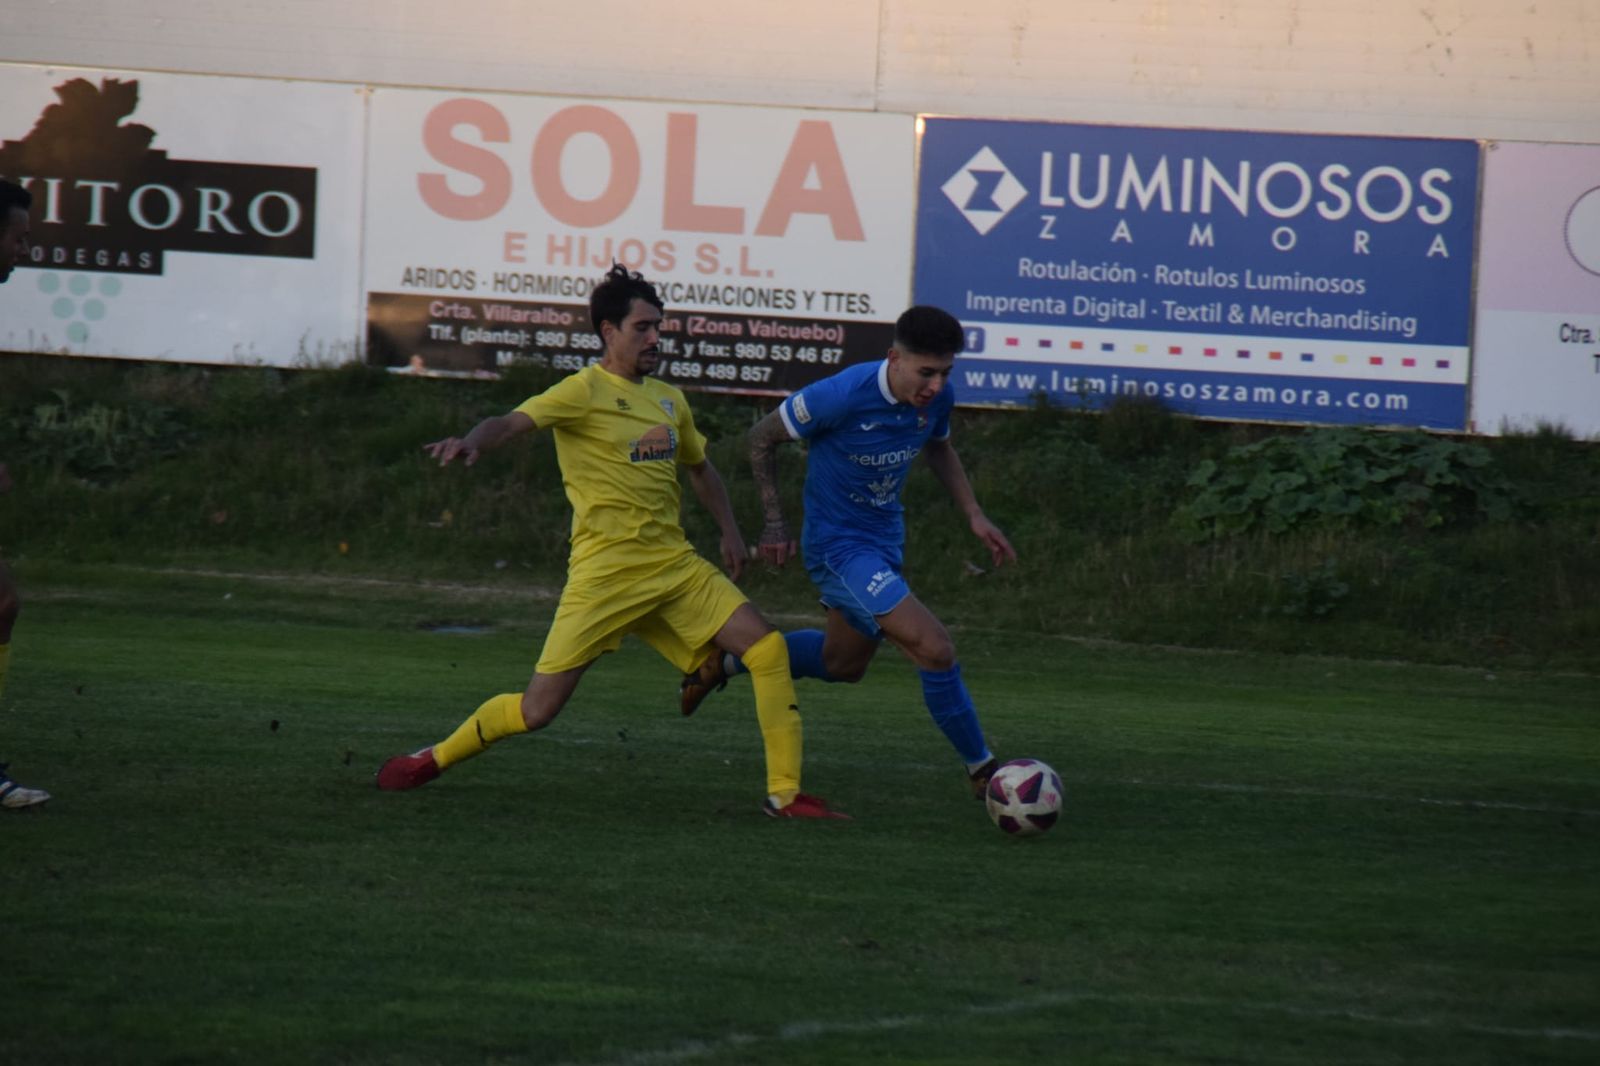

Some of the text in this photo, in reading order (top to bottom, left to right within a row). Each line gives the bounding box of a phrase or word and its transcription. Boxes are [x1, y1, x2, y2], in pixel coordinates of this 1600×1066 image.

[416, 97, 866, 242] SOLA
[1040, 151, 1452, 225] LUMINOSOS
[0, 174, 302, 238] ITORO
[30, 246, 153, 269] ODEGAS
[503, 231, 775, 278] E HIJOS S.L.
[402, 267, 476, 291] ARIDOS
[803, 291, 816, 311] Y
[822, 291, 875, 315] TTES.
[1018, 258, 1137, 283] Rotulación
[1154, 265, 1238, 288] Rotulos
[1245, 269, 1366, 295] Luminosos
[428, 301, 477, 320] Crta.
[482, 304, 572, 326] Villaralbo
[686, 315, 744, 337] (Zona
[748, 318, 845, 344] Valcuebo)
[966, 291, 1067, 316] Imprenta
[1073, 296, 1146, 323] Digital
[1162, 300, 1222, 323] Textil
[1227, 304, 1244, 324] &
[1250, 304, 1417, 338] Merchandising
[460, 326, 531, 348] (planta):
[535, 330, 567, 348] 980
[1560, 323, 1596, 344] Ctra.
[683, 343, 694, 359] y
[697, 340, 731, 358] fax:
[735, 342, 767, 360] 980
[770, 345, 792, 362] 53
[796, 346, 818, 363] 46
[821, 348, 844, 365] 87
[670, 362, 701, 378] 659
[705, 364, 737, 381] 489
[740, 366, 773, 383] 857
[965, 370, 1409, 410] www.luminososzamora.com
